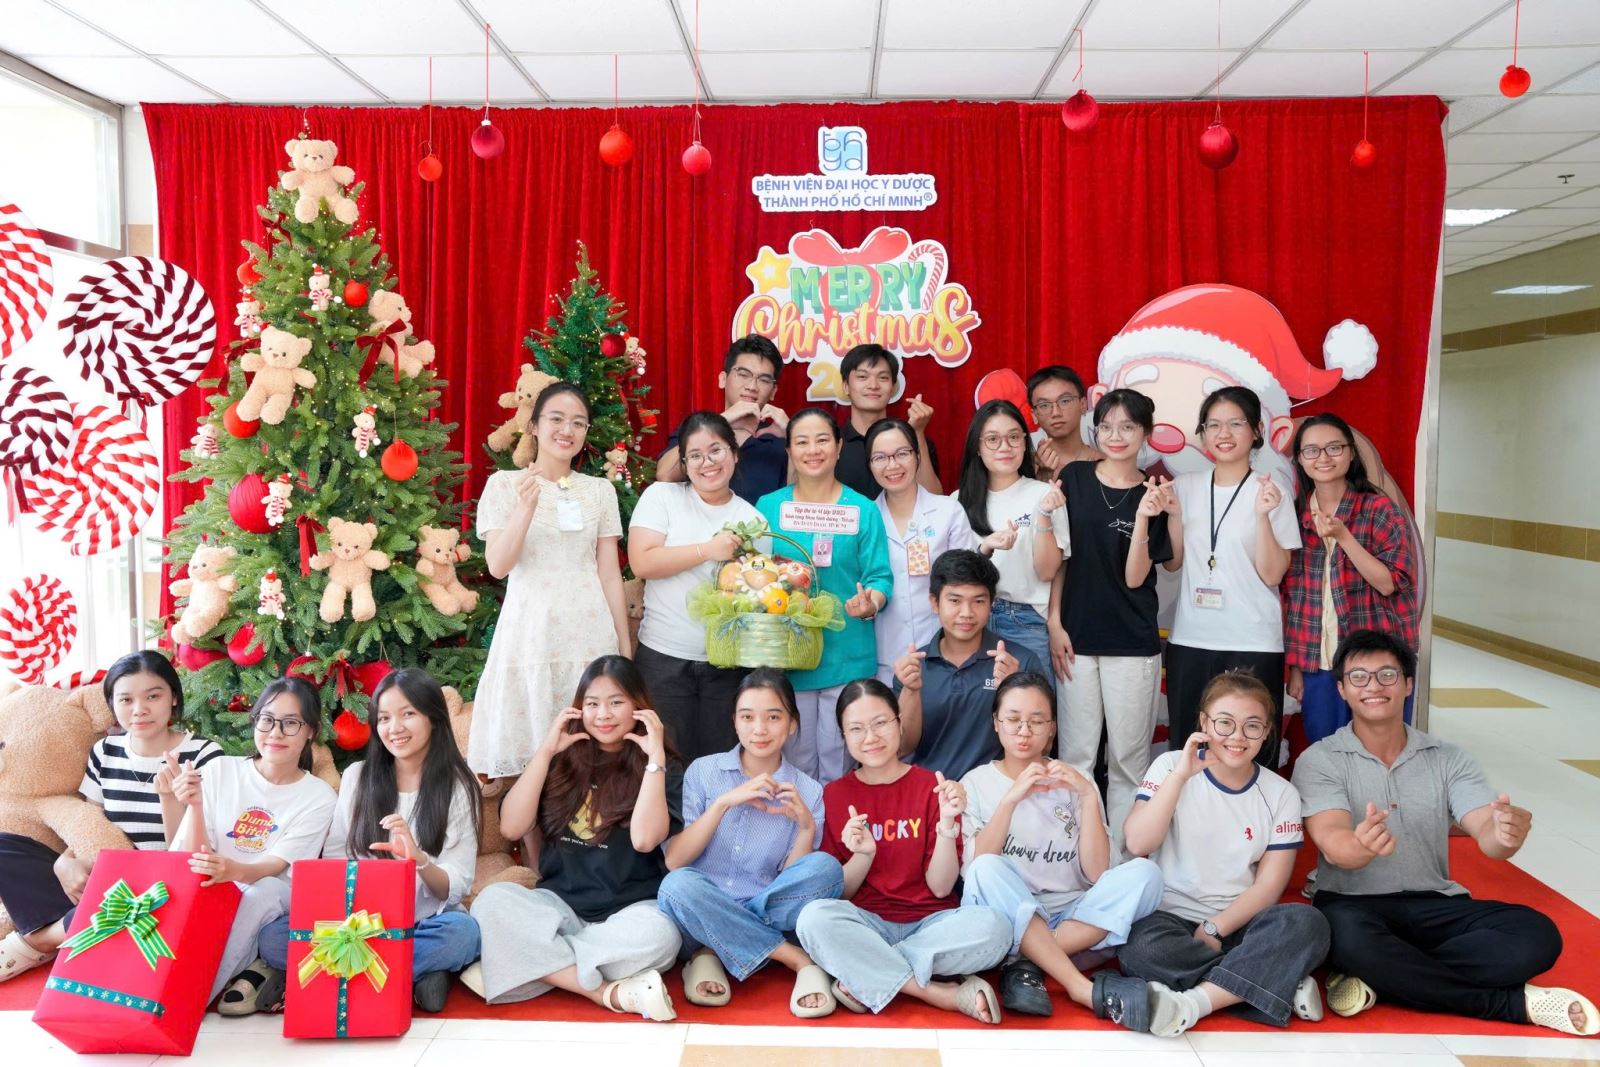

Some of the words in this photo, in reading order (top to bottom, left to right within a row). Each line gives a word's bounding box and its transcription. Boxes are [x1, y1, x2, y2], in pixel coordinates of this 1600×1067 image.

[756, 178, 790, 193] BỆNH
[793, 178, 823, 193] VIỆN
[825, 179, 848, 192] ĐẠI
[851, 179, 879, 192] HỌC
[881, 179, 889, 190] Y
[892, 177, 931, 192] DƯỢC
[763, 194, 808, 207] THÀNH
[811, 193, 839, 207] PHỐ
[842, 193, 860, 207] HỒ
[864, 193, 885, 206] CHÍ
[790, 262, 927, 314] MERRY
[736, 287, 978, 363] Christmas
[239, 812, 273, 826] Dumb
[236, 823, 270, 839] Bitch
[866, 817, 921, 842] UCKY
